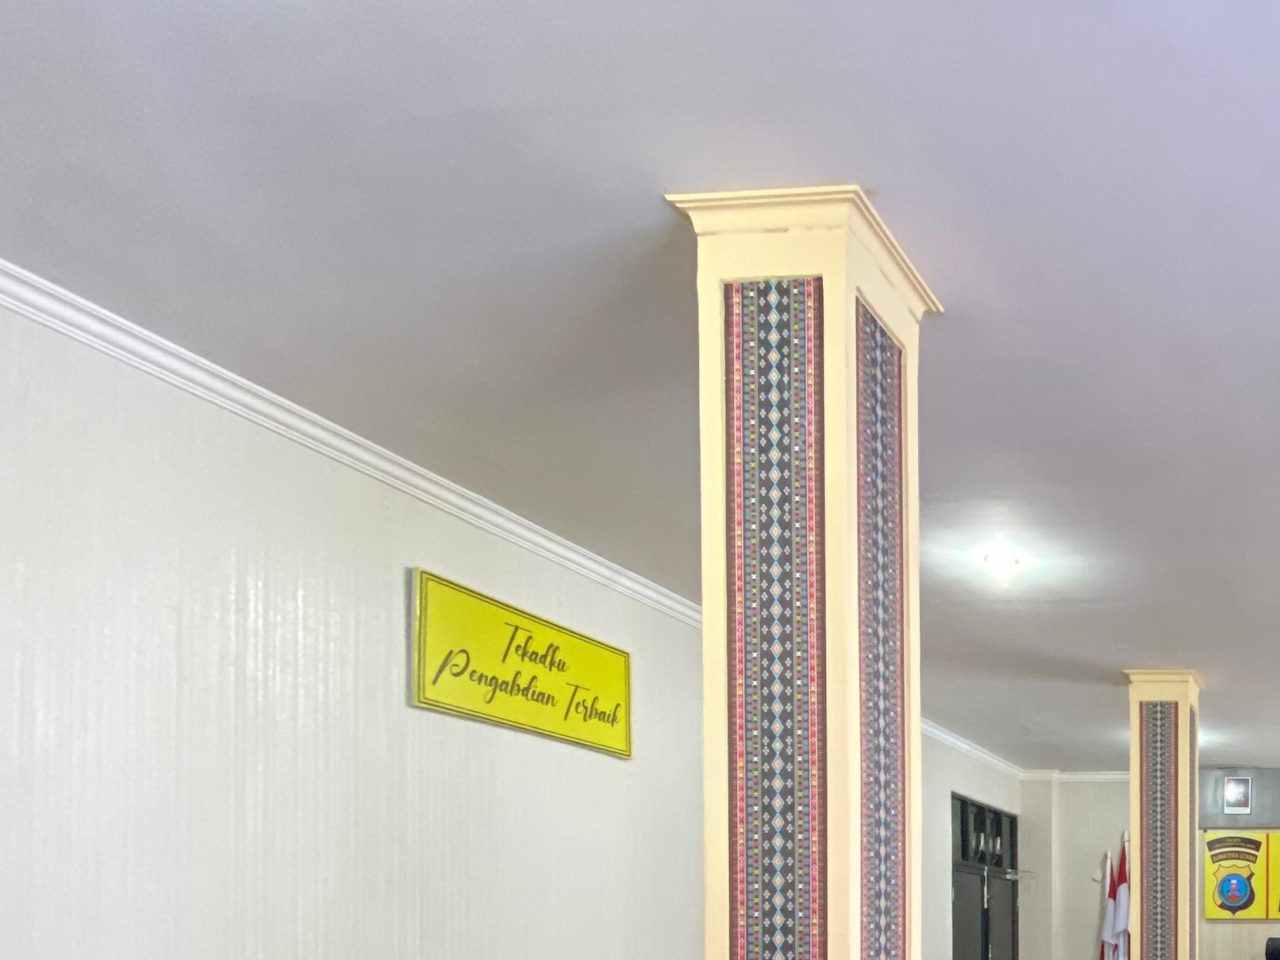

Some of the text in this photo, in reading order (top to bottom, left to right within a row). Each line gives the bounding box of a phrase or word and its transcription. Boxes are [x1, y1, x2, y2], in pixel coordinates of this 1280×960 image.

[503, 622, 568, 672] Tekadku
[432, 648, 621, 727] Pengabdian Terbaik
